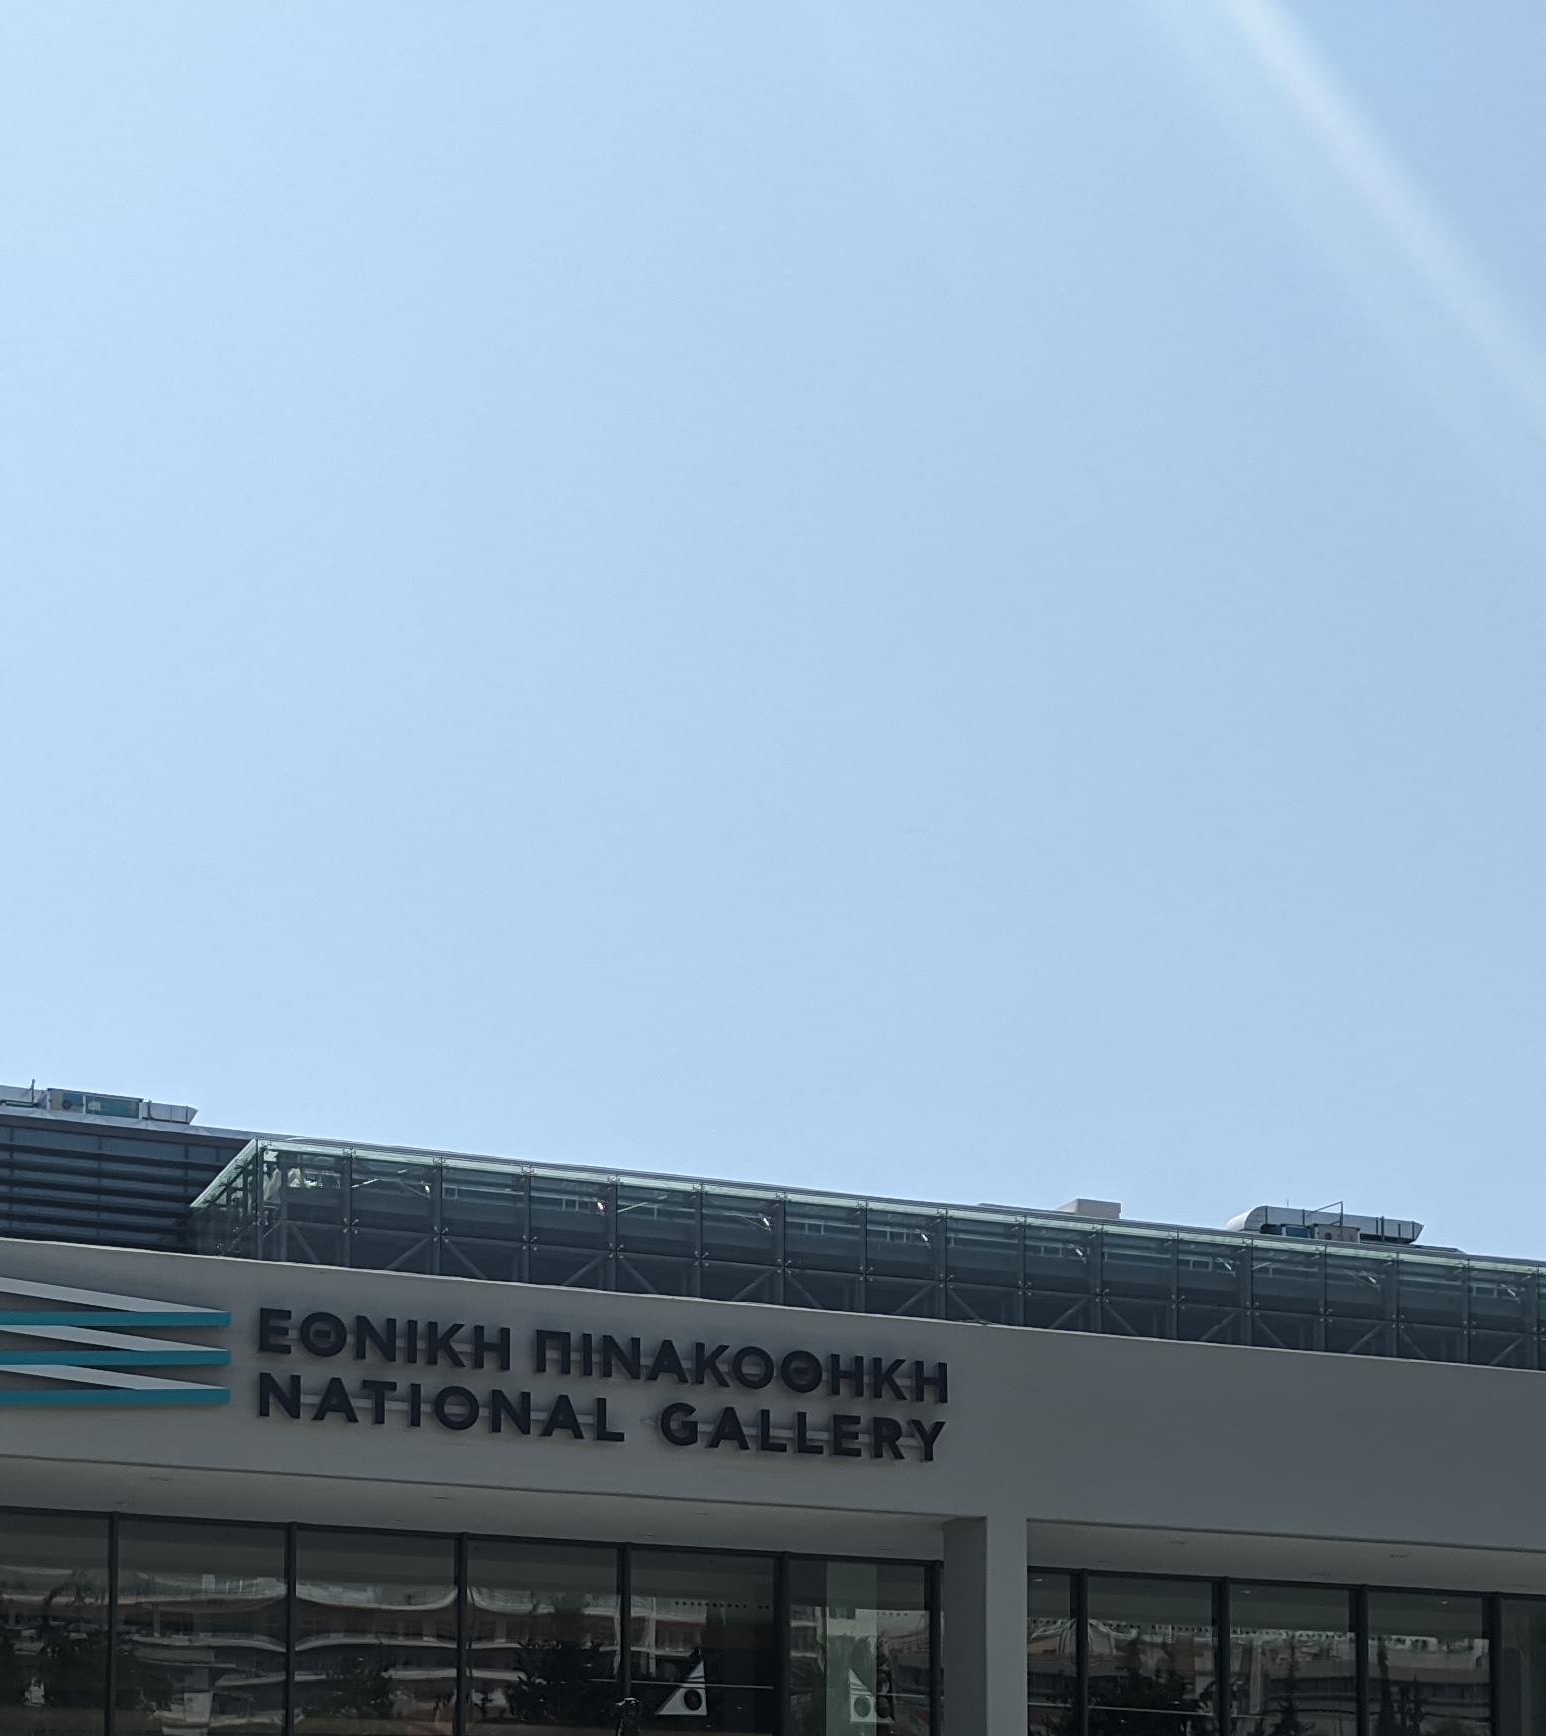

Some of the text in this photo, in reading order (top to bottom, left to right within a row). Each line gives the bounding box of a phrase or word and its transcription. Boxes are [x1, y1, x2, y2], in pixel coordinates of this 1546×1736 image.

[258, 1307, 948, 1404] ΕΘΝΙΚΗ ΠΙΝΑΚΟΘΗΚΗ
[257, 1373, 946, 1462] NATIONAL GALLERY
